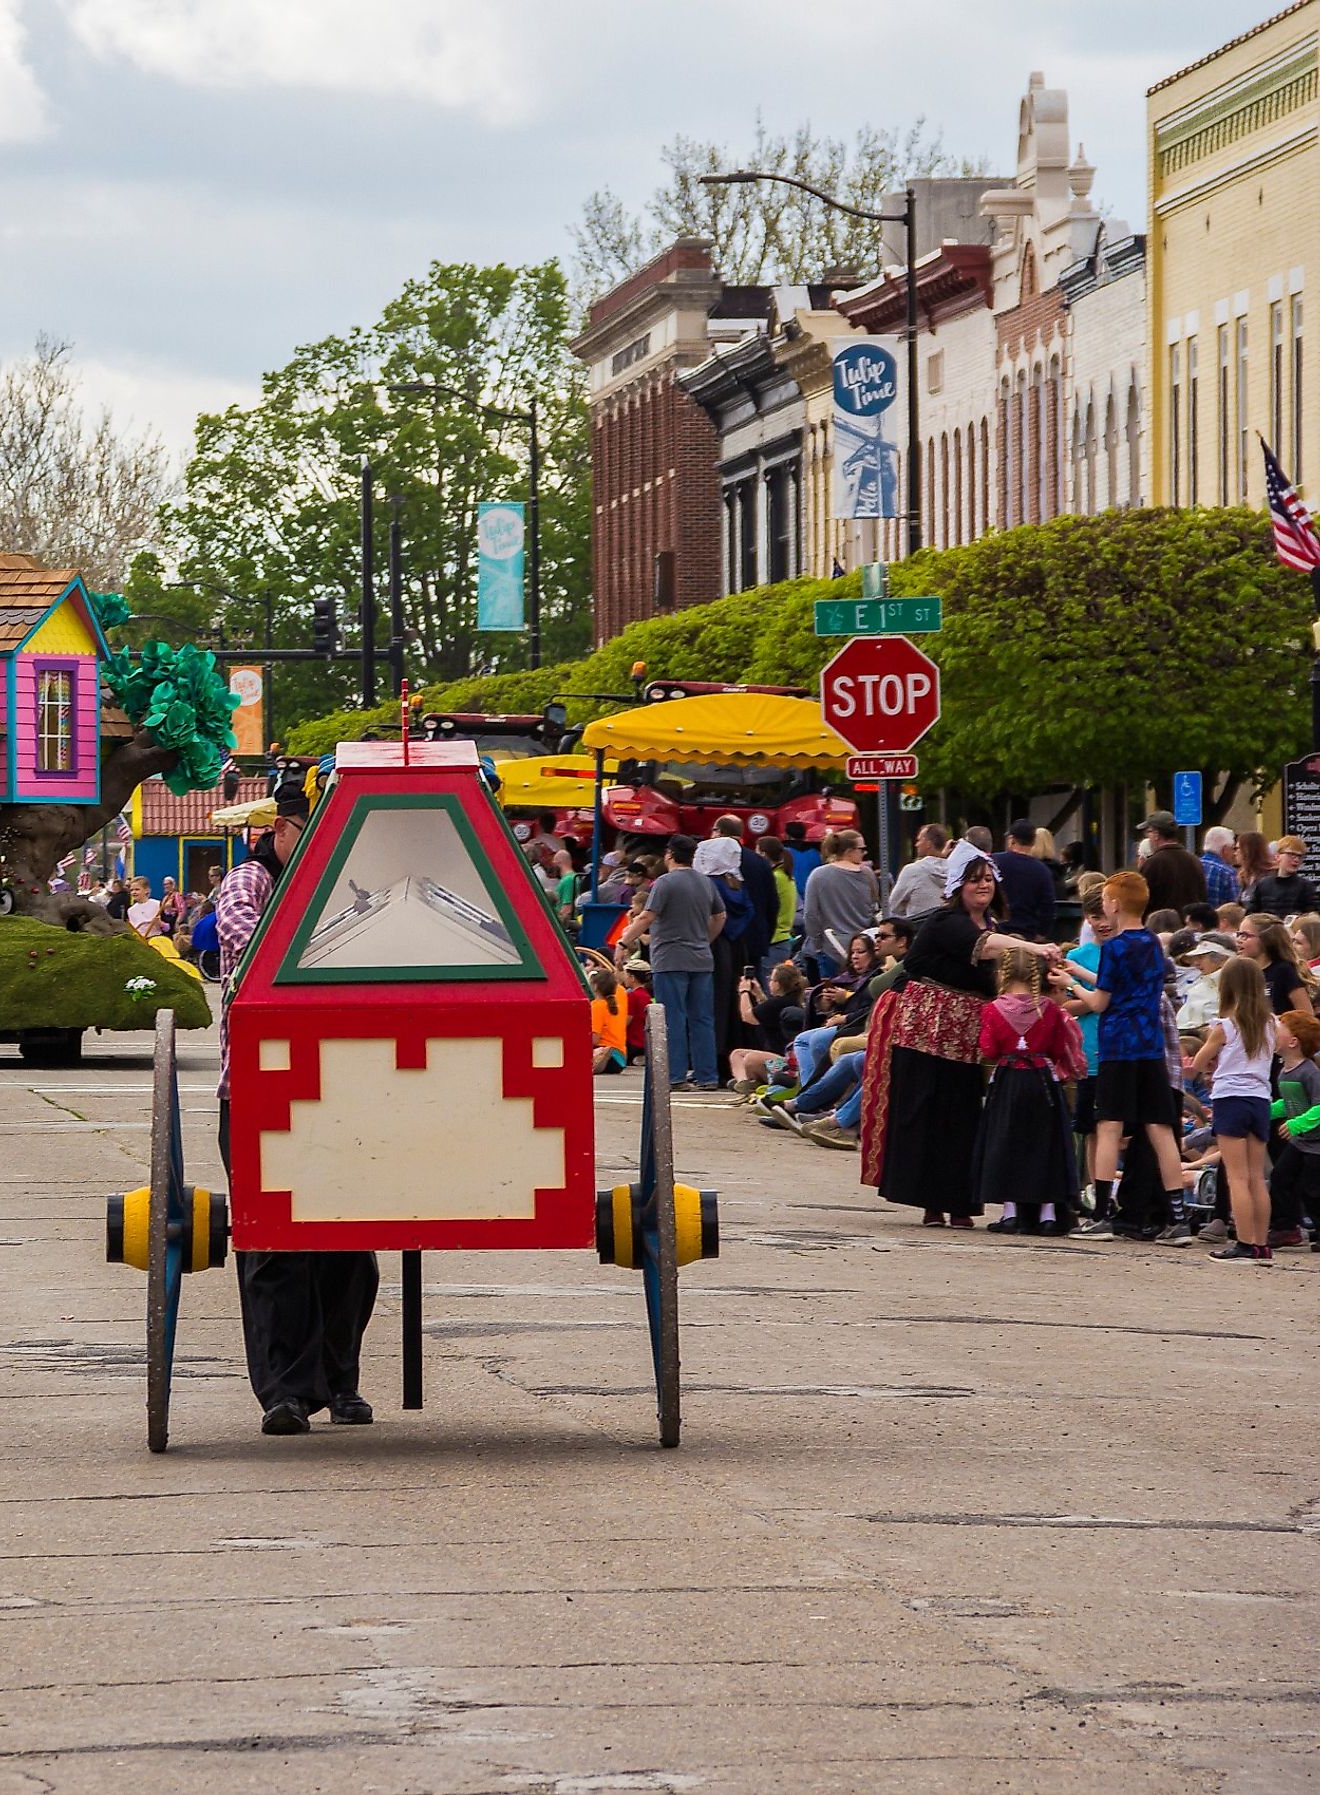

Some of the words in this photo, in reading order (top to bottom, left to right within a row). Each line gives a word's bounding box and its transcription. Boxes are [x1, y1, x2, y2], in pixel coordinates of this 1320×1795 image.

[835, 355, 886, 388] Tulip
[847, 382, 896, 410] Time
[855, 604, 869, 630] E
[915, 608, 930, 622] ST
[831, 673, 931, 717] STOP
[852, 761, 878, 775] ALL
[883, 759, 911, 774] WAY
